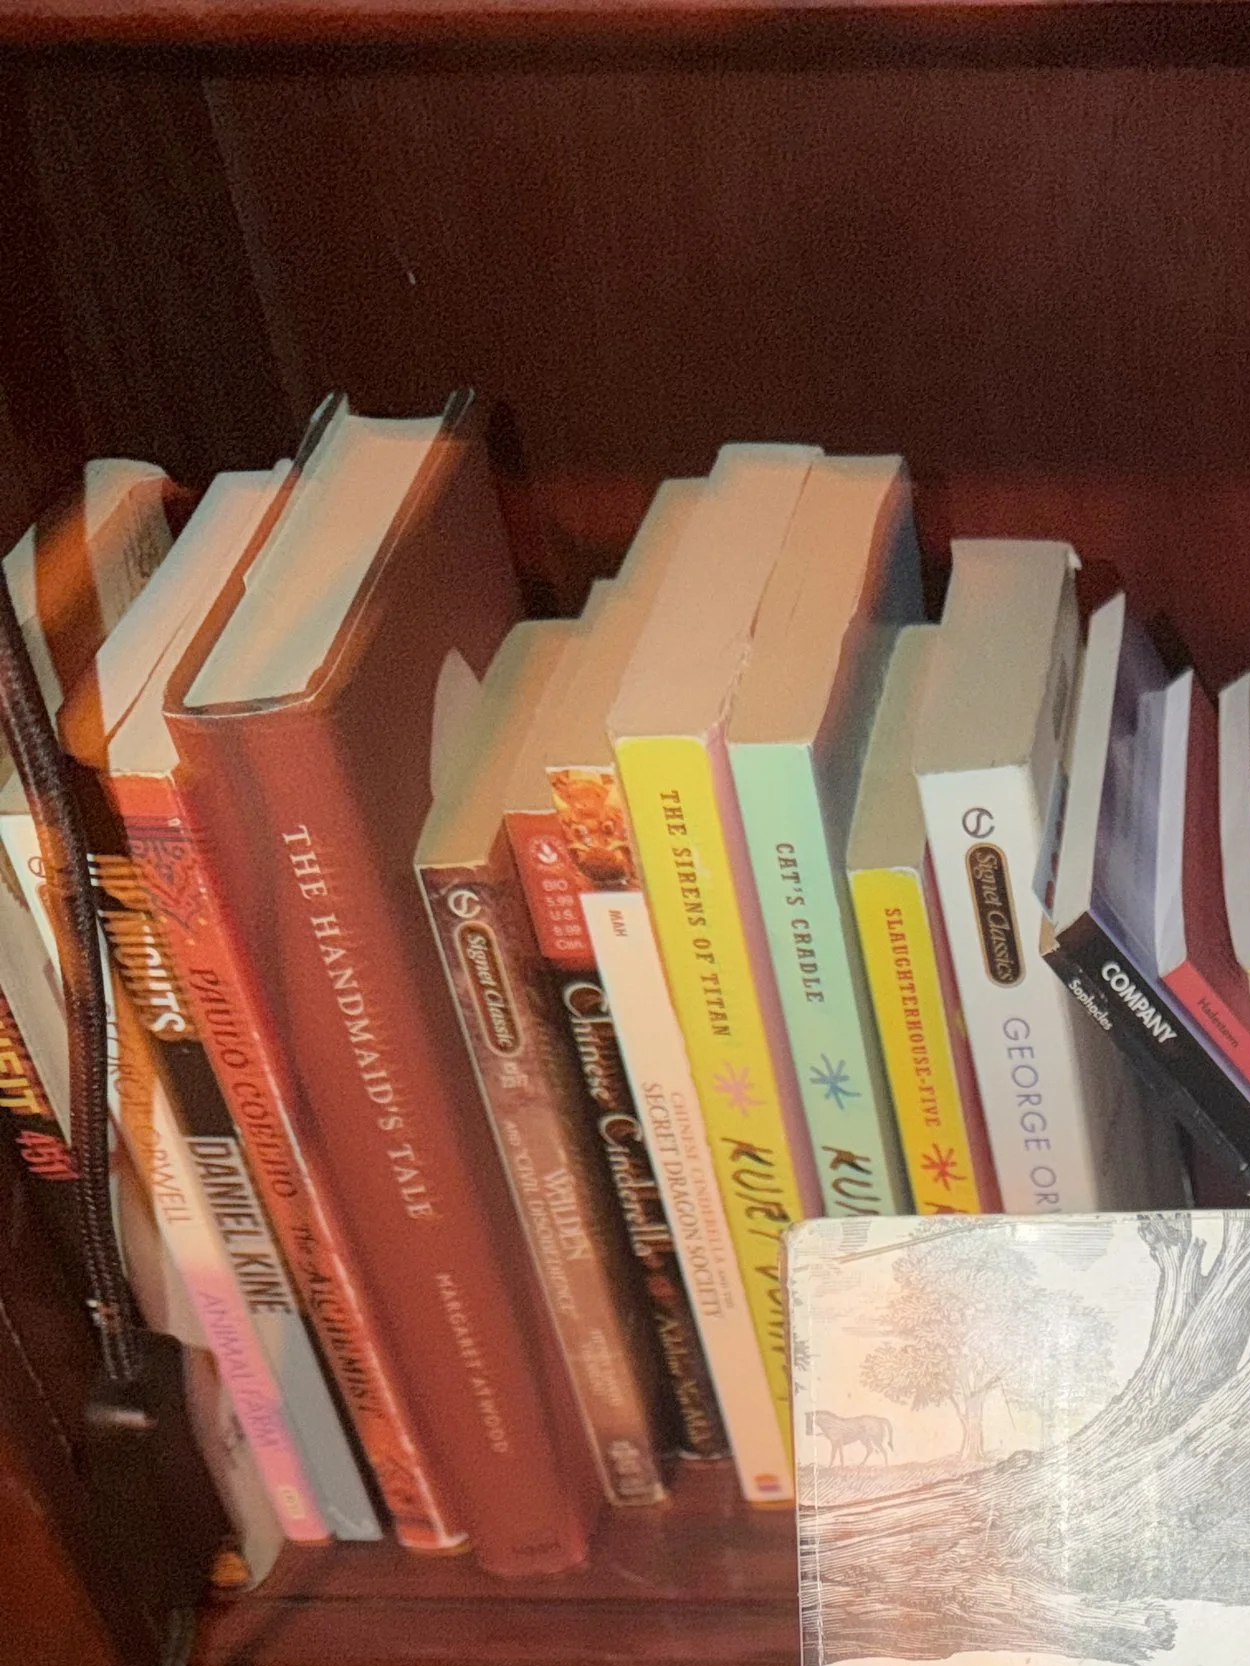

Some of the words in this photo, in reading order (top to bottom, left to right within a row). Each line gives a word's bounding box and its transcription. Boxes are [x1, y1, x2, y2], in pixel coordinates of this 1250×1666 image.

[659, 790, 688, 837] THE
[671, 845, 706, 928] SIRENS
[776, 842, 806, 906] CAT'S
[791, 918, 825, 1004] CRADLE
[974, 851, 1003, 908] Signet
[467, 933, 496, 986] Signet
[692, 937, 715, 967] OF
[282, 824, 328, 900] THE
[309, 912, 404, 1133] HANDMAID'S
[387, 1142, 435, 1220] TALE
[700, 972, 732, 1038] TITAN
[884, 907, 942, 1129] SLAUGHTERHOUSE-FIVE
[1067, 979, 1114, 1031] Sophocles
[1100, 960, 1178, 1044] COMPANY
[188, 966, 252, 1070] PAULO
[231, 1081, 298, 1200] COELHO
[563, 981, 616, 1107] Chinese
[600, 1112, 674, 1258] Cinderella
[1002, 1017, 1052, 1153] GEORGE
[139, 1125, 193, 1225] ORWELL
[642, 1081, 680, 1156] SECRET
[662, 1160, 703, 1243] DRAGON
[687, 1243, 723, 1320] SOCIETY
[189, 1138, 264, 1245] DANIEL
[233, 1247, 292, 1316] KINE
[198, 1288, 248, 1385] ANIMAL
[436, 1272, 486, 1371] MARGARET
